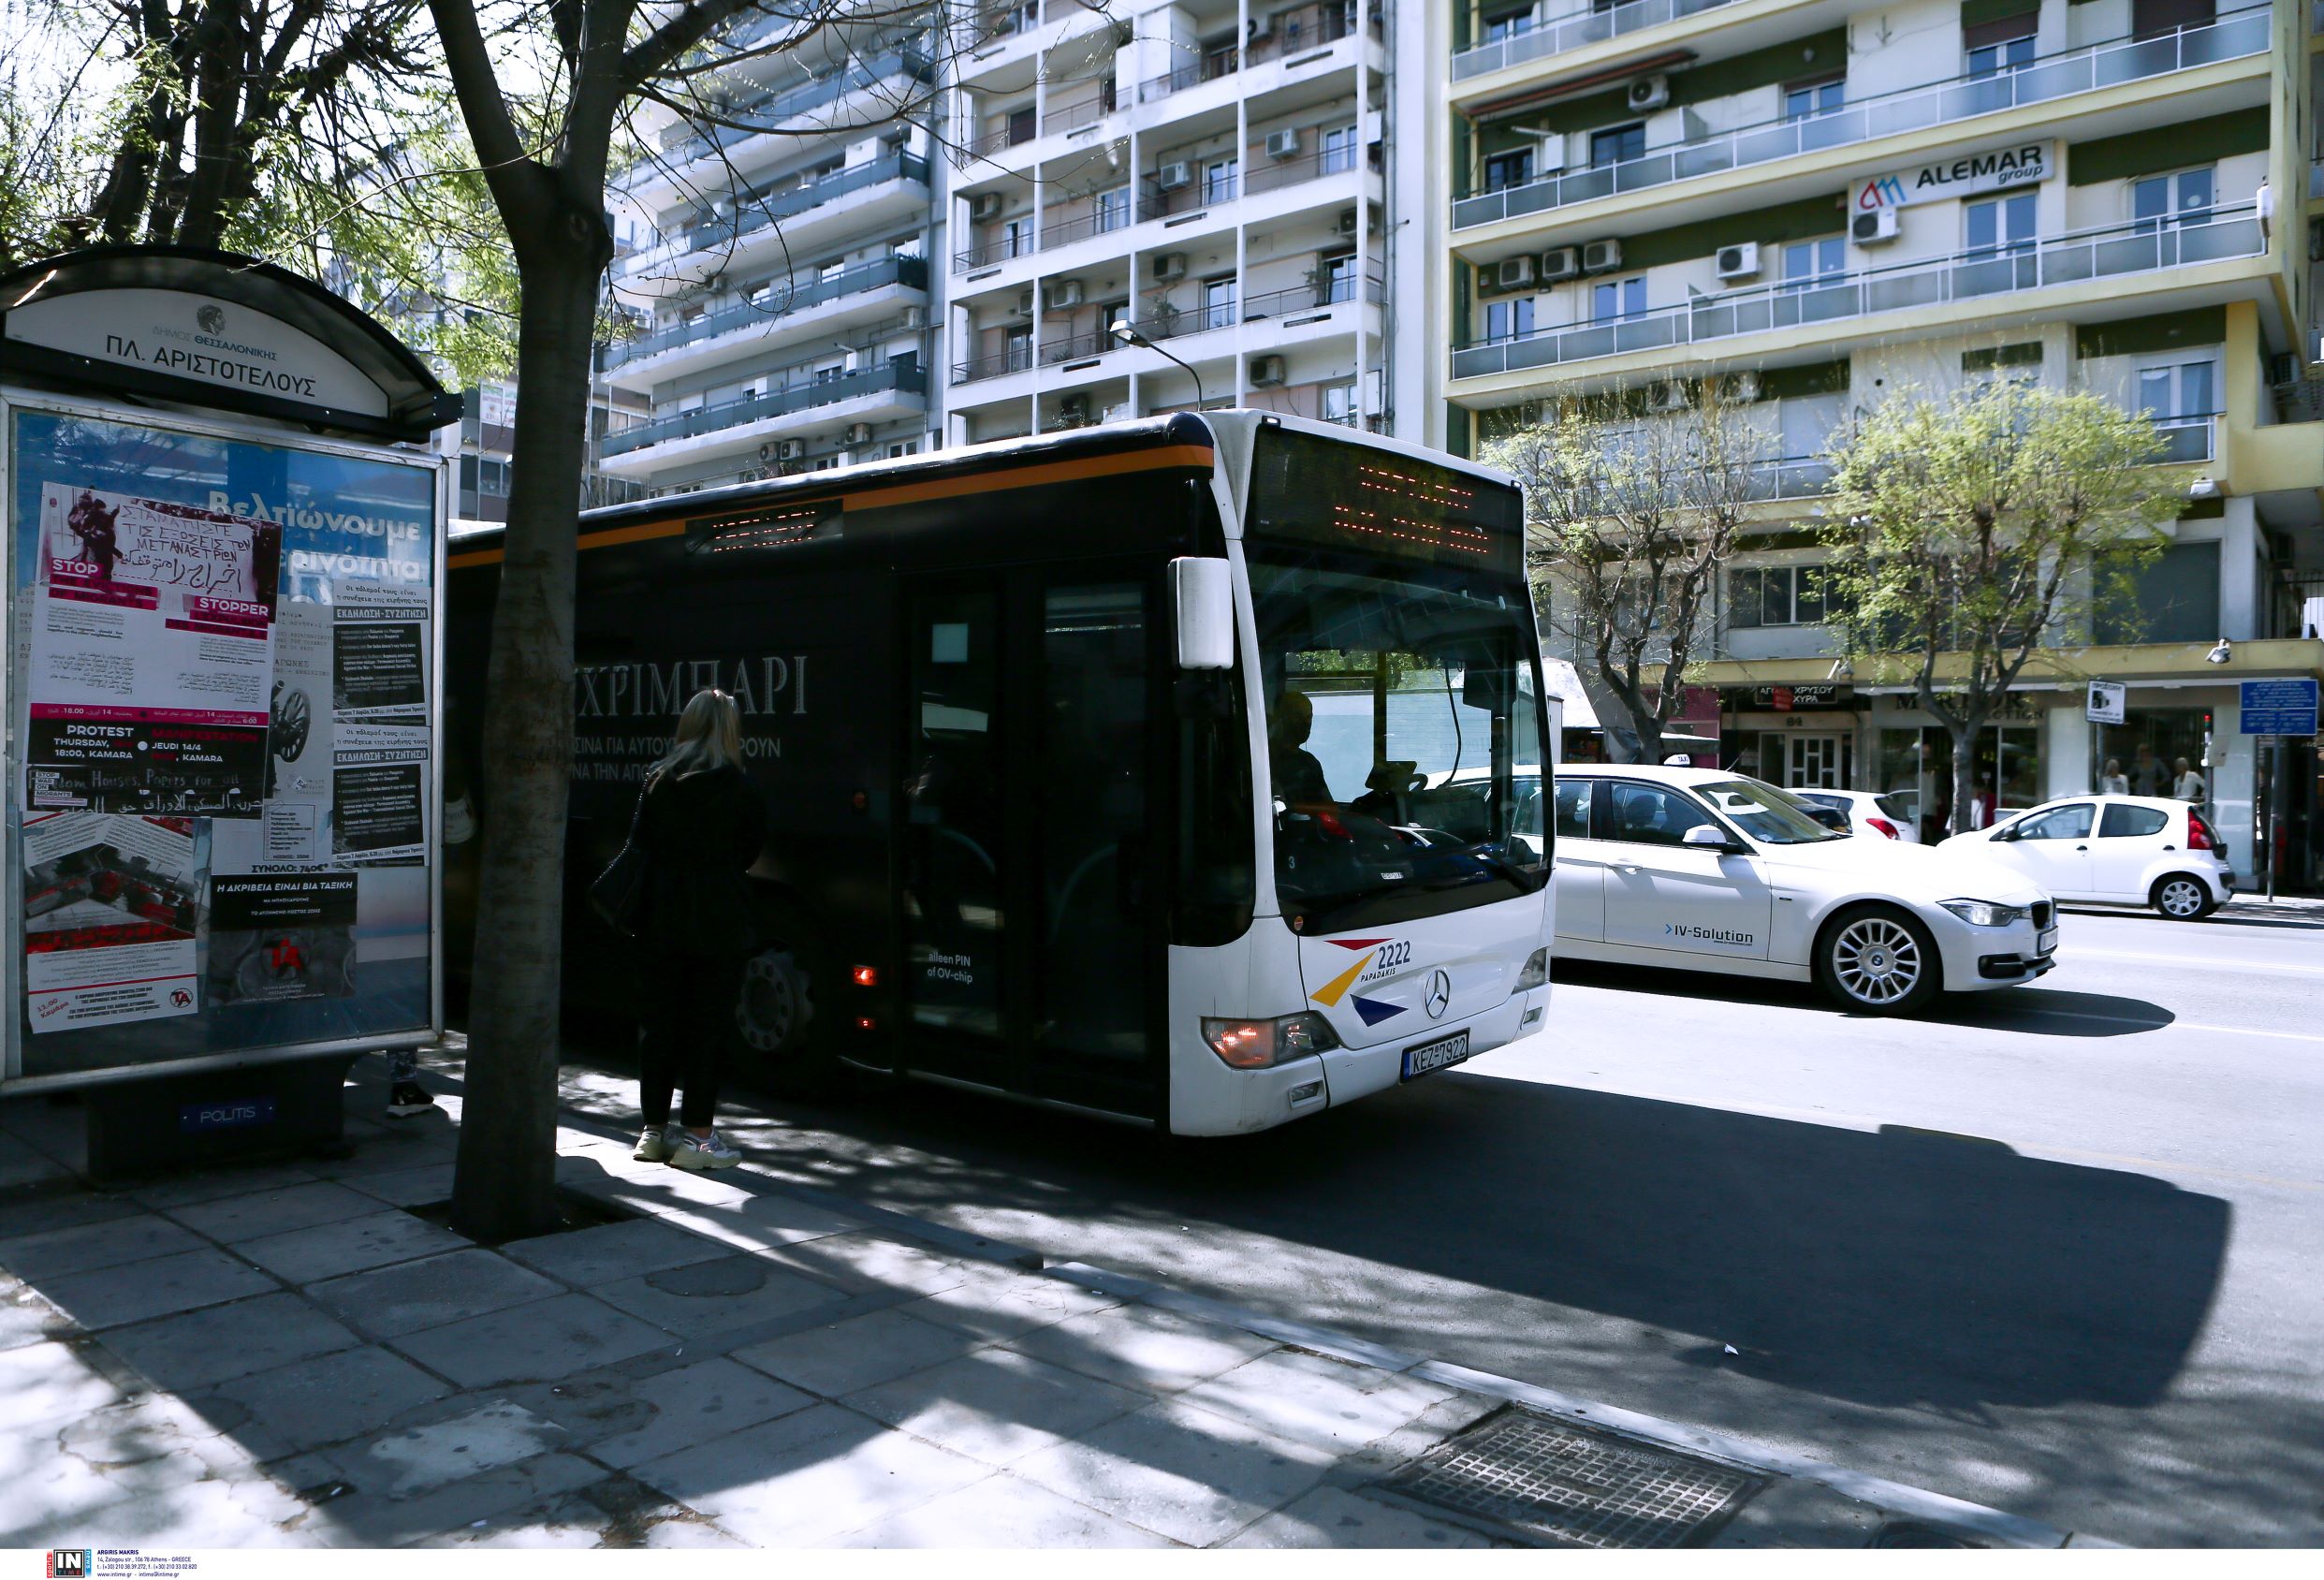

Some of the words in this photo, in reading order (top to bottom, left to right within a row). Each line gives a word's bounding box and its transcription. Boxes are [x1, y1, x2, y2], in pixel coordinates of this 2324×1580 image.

[1917, 145, 2042, 189] ALEMAR
[1997, 164, 2043, 185] group
[195, 335, 277, 361] ΘΕΣΣΑΛΟΝΙΚΗΣ
[106, 334, 146, 361] ΠΛ.
[153, 346, 316, 398] ΑΡΙΣΤΟΤΕΛΟΥΣ
[52, 559, 98, 574] STOP
[199, 597, 269, 617] STOPPER
[574, 655, 808, 718] ΧΡΙΜΠΑΡΙ
[66, 724, 134, 738] PROTEST
[53, 738, 110, 748] THURSDAY,
[152, 742, 179, 751] JEUDI
[575, 737, 603, 754] ΣΙΝΑ
[607, 737, 624, 755] ΓΙΑ
[54, 750, 85, 758] 18:00,
[89, 750, 133, 759] KAMARA
[183, 753, 224, 763] KAMARA
[592, 763, 619, 781] ΤΗΝ
[252, 864, 298, 873] ΣΥΝΟΛΟ:
[1288, 856, 1295, 869] 3
[216, 885, 225, 893] Η
[227, 883, 272, 892] ΑΚΡΙΒΕΙΑ
[275, 882, 300, 891] ΕΙΝΑΙ
[302, 882, 318, 890] ΒΙΑ
[320, 881, 353, 889] ΤΑΞΙΚΗ
[1674, 925, 1753, 943] IV-Solution
[928, 951, 954, 965] alleen
[955, 955, 971, 967] PIN
[1378, 940, 1410, 970] 2222
[928, 967, 936, 977] of
[937, 968, 973, 985] OV-chip
[1360, 967, 1396, 983] PAPADAKIS
[200, 1106, 256, 1123] POLITIS
